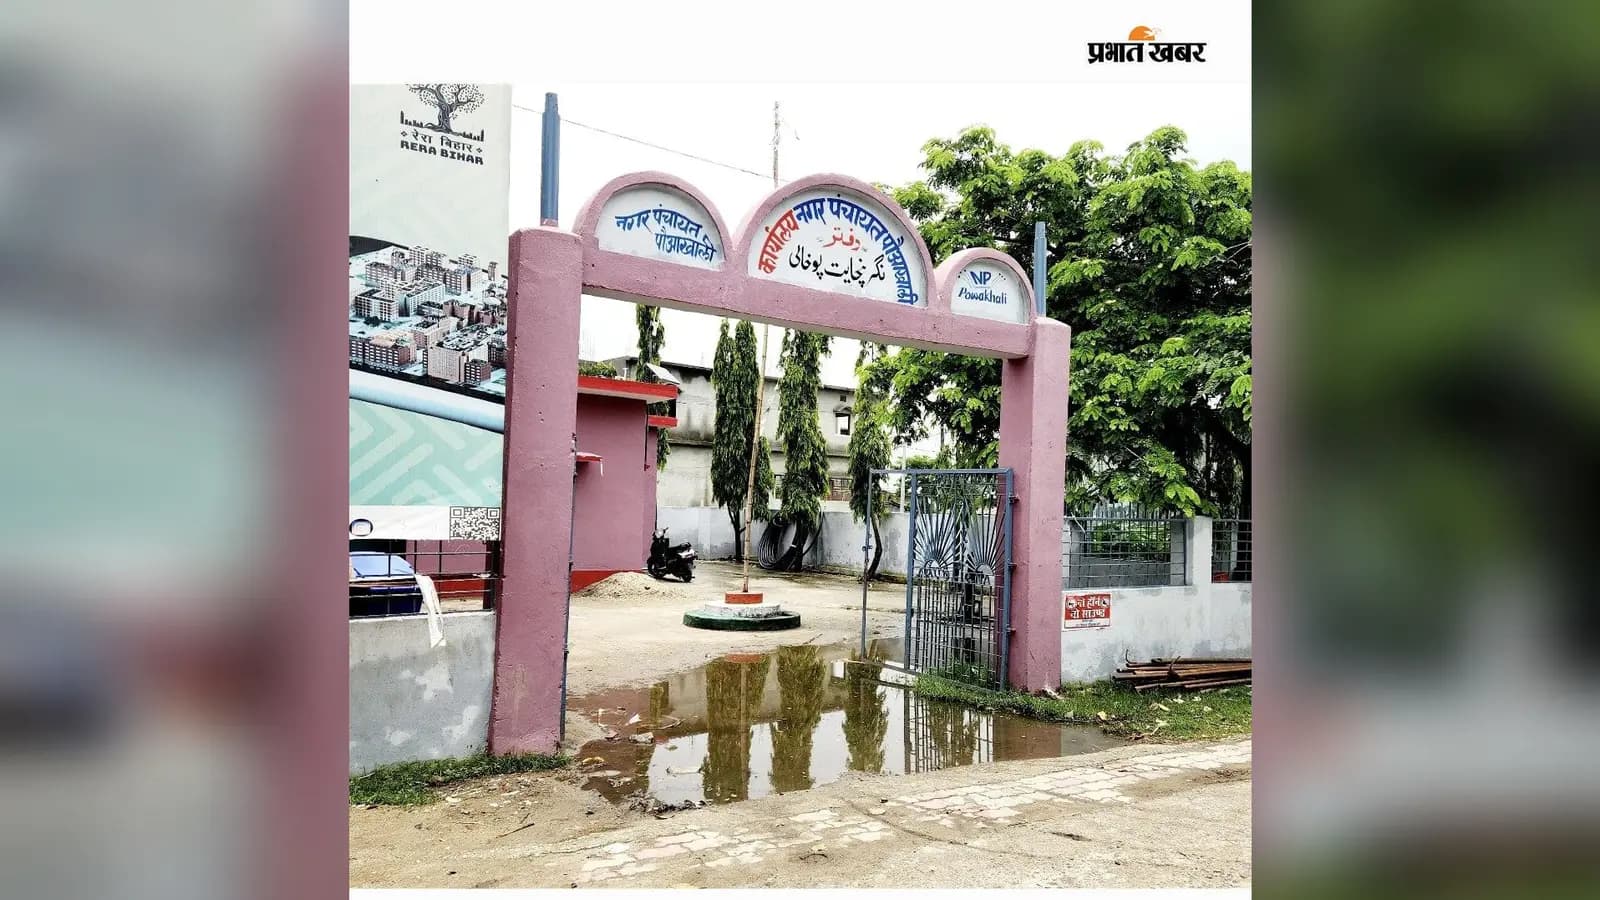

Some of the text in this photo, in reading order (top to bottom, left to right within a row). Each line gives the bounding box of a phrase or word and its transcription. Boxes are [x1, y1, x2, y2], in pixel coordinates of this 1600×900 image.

[411, 128, 473, 152] रेरा बिहार
[400, 140, 484, 165] RERA BIHAR
[615, 203, 703, 238] नगर पंचायत
[793, 198, 826, 225] नगर
[827, 194, 888, 241] पंचायत
[822, 227, 861, 251] دفتر
[866, 254, 886, 286] نگر
[970, 271, 992, 285] NP
[958, 287, 1007, 304] Powakhali
